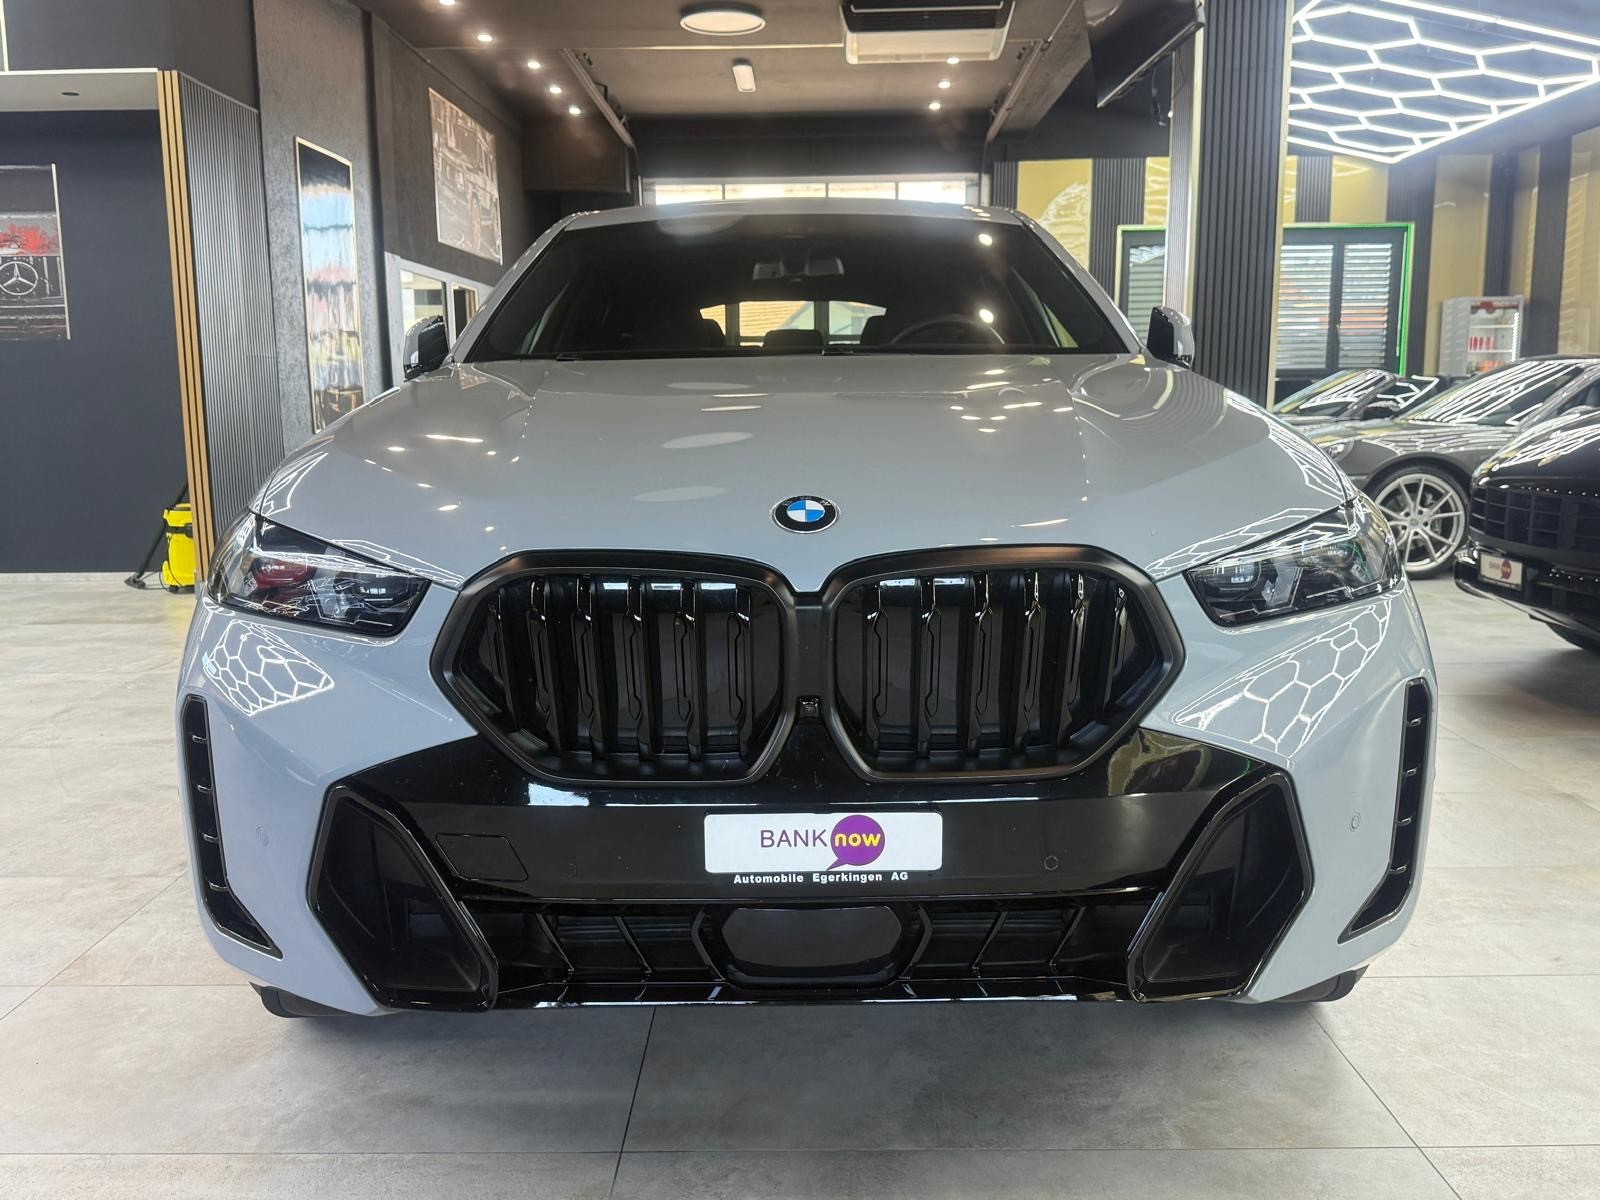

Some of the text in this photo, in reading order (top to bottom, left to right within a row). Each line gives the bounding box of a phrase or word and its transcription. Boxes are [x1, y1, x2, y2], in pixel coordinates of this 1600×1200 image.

[760, 829, 881, 848] BANK now
[733, 871, 908, 884] Automobile Egerkingen AG
